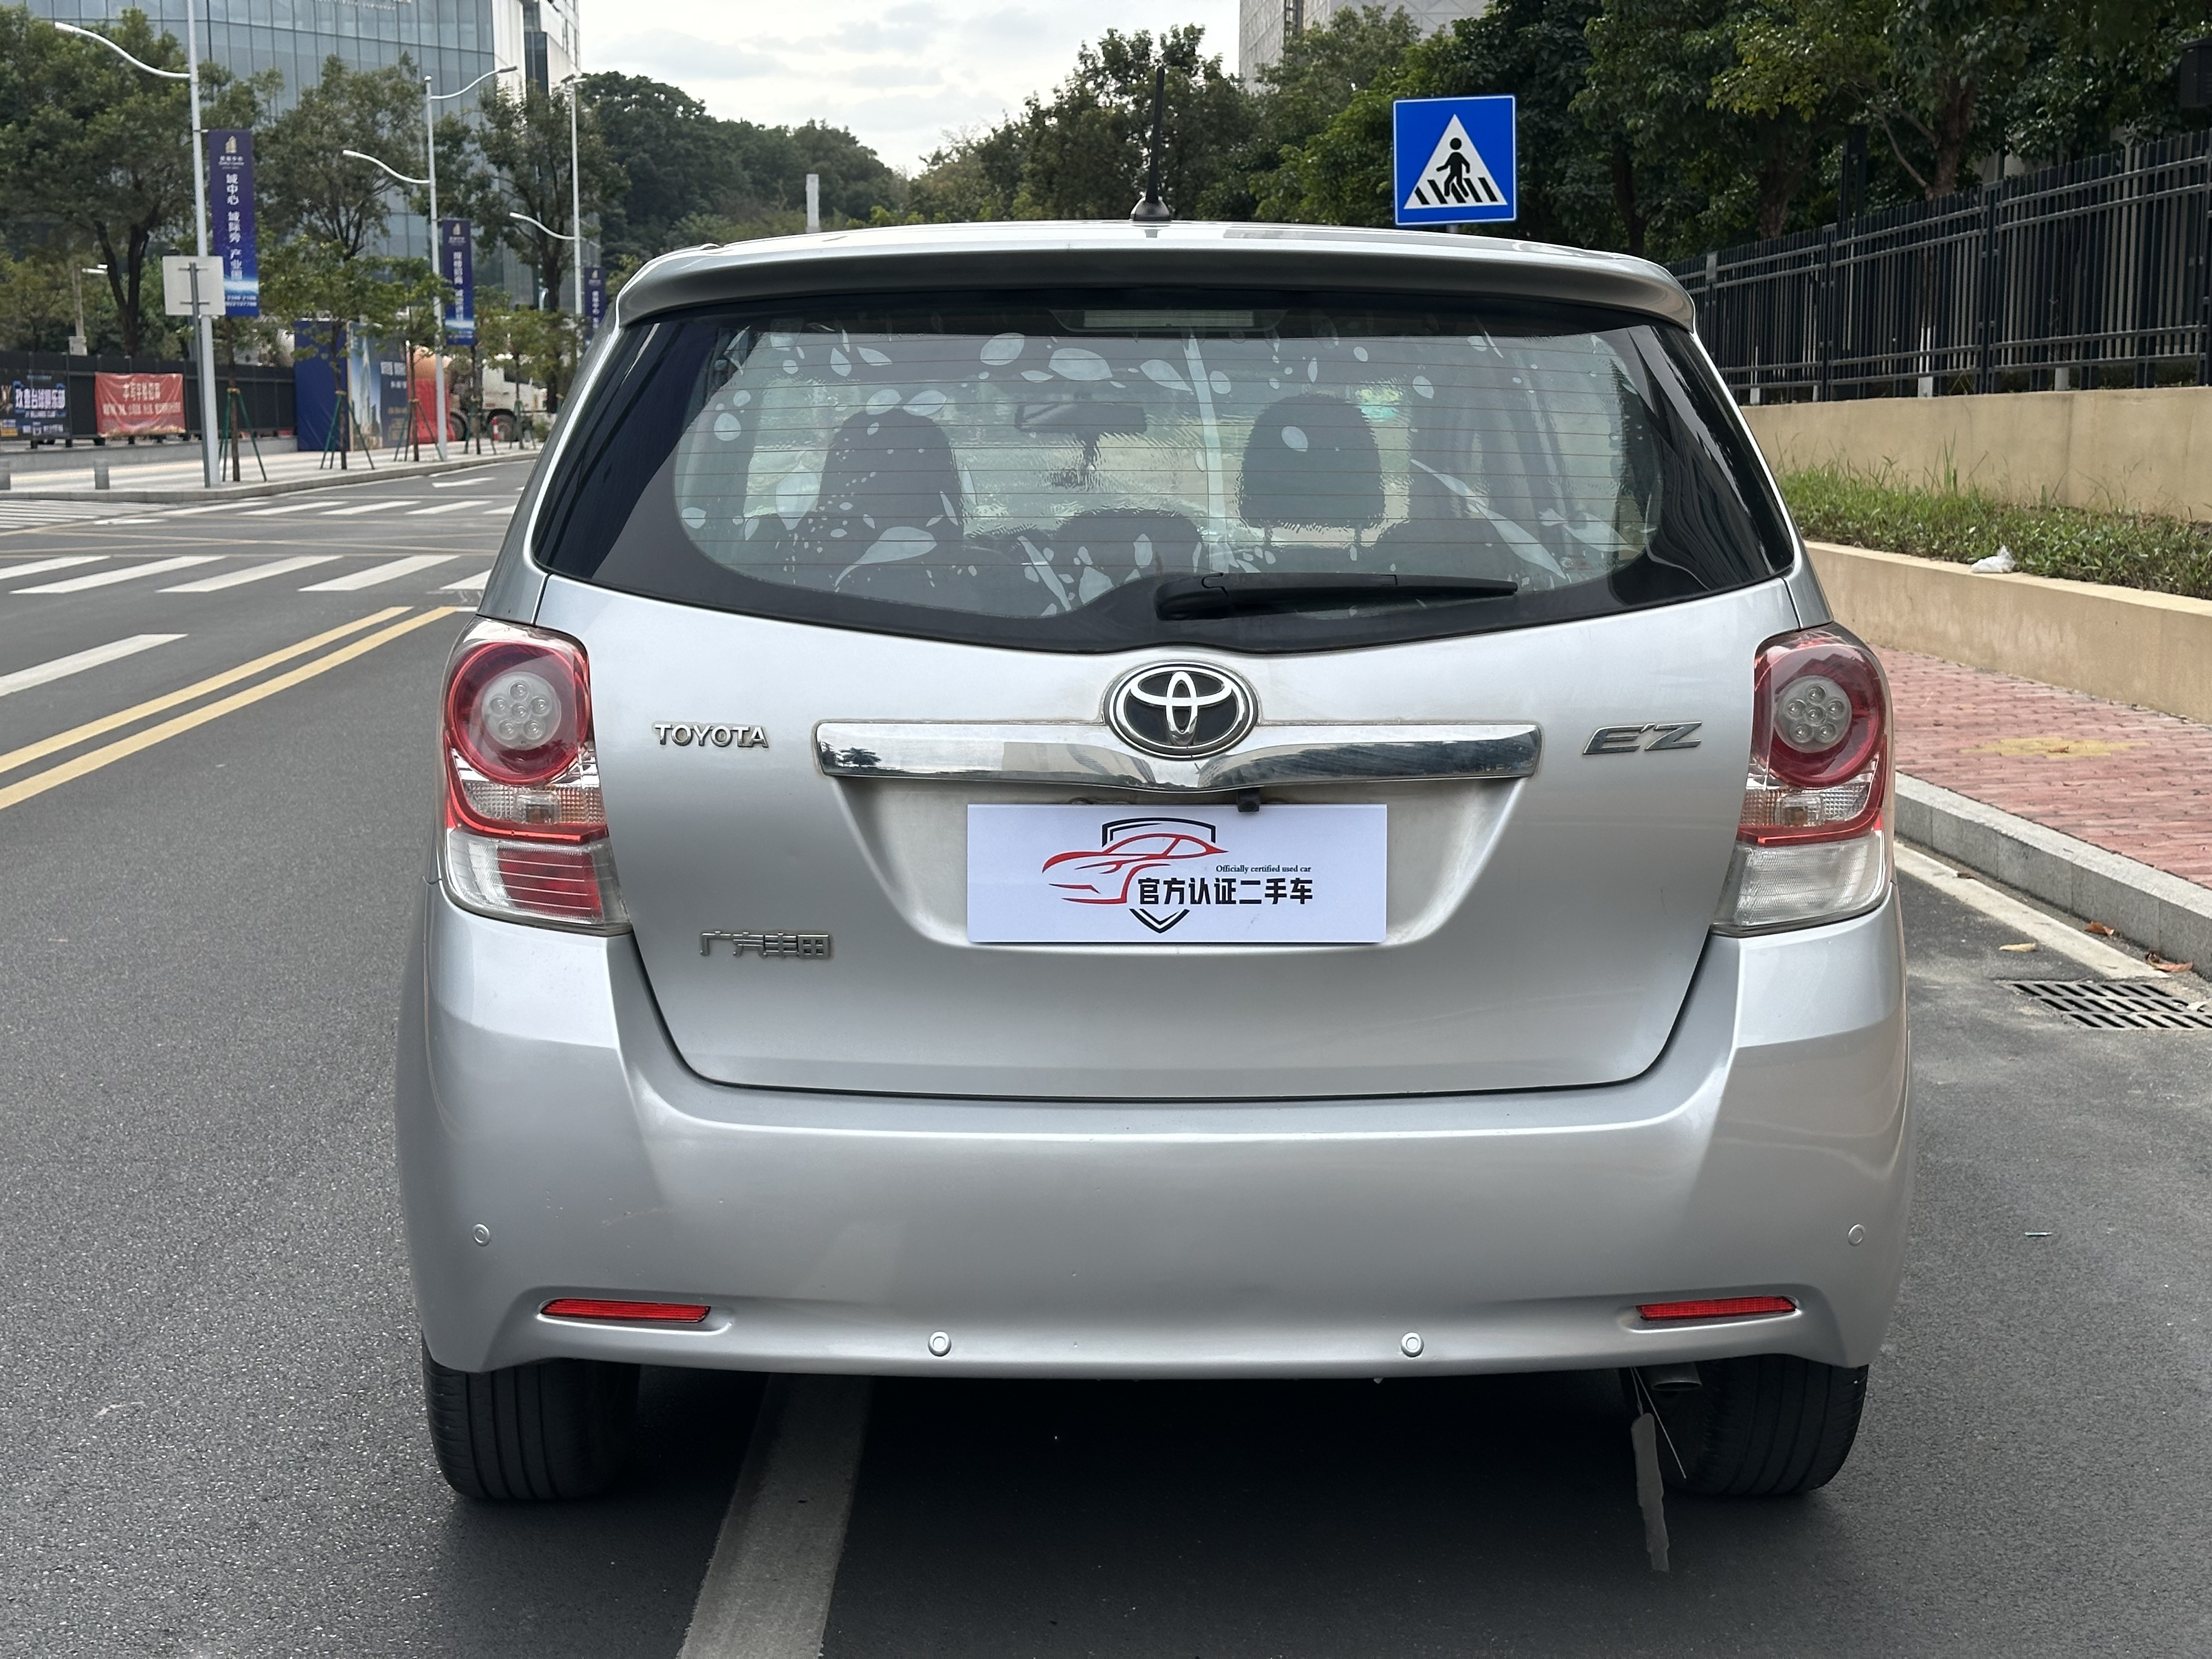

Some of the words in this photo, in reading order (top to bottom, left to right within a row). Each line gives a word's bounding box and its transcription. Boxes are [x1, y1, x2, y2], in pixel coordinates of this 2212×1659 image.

[226, 173, 240, 205] 城中心
[654, 724, 769, 748] TOYOTA
[1216, 865, 1249, 874] Officially
[1137, 877, 1313, 905] 官方认证二手车
[699, 930, 830, 960] 广汽丰田
